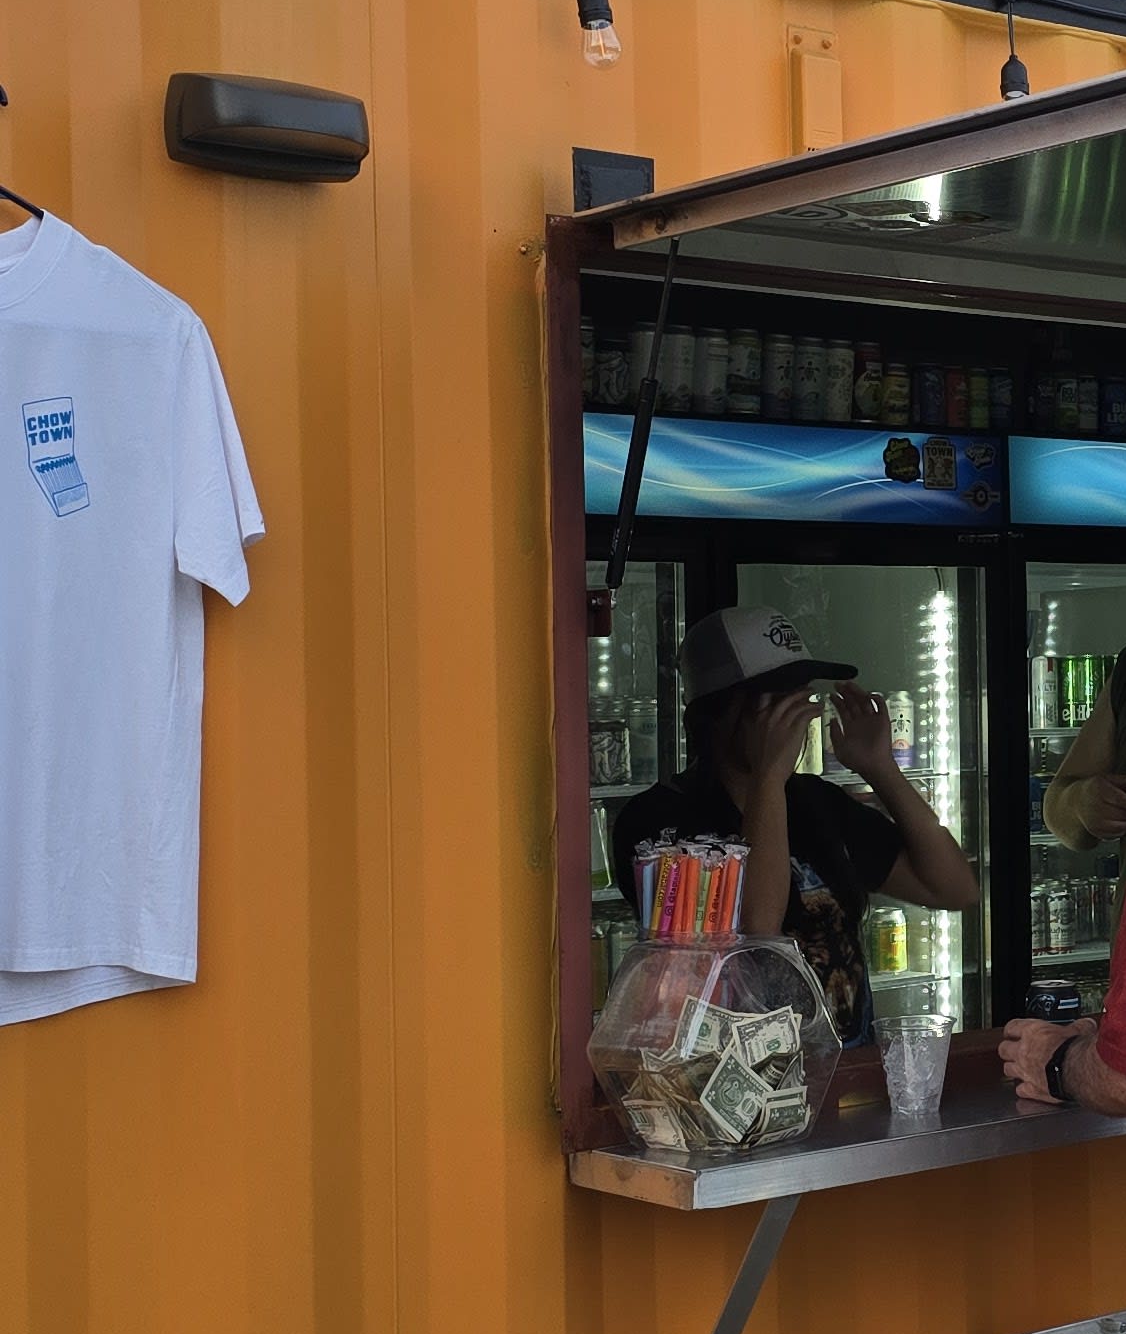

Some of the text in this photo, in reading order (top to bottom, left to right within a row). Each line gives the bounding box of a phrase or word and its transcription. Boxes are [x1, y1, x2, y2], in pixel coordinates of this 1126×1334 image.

[27, 410, 72, 432] CHOW
[28, 425, 73, 446] TOWN
[926, 446, 953, 457] TOWN
